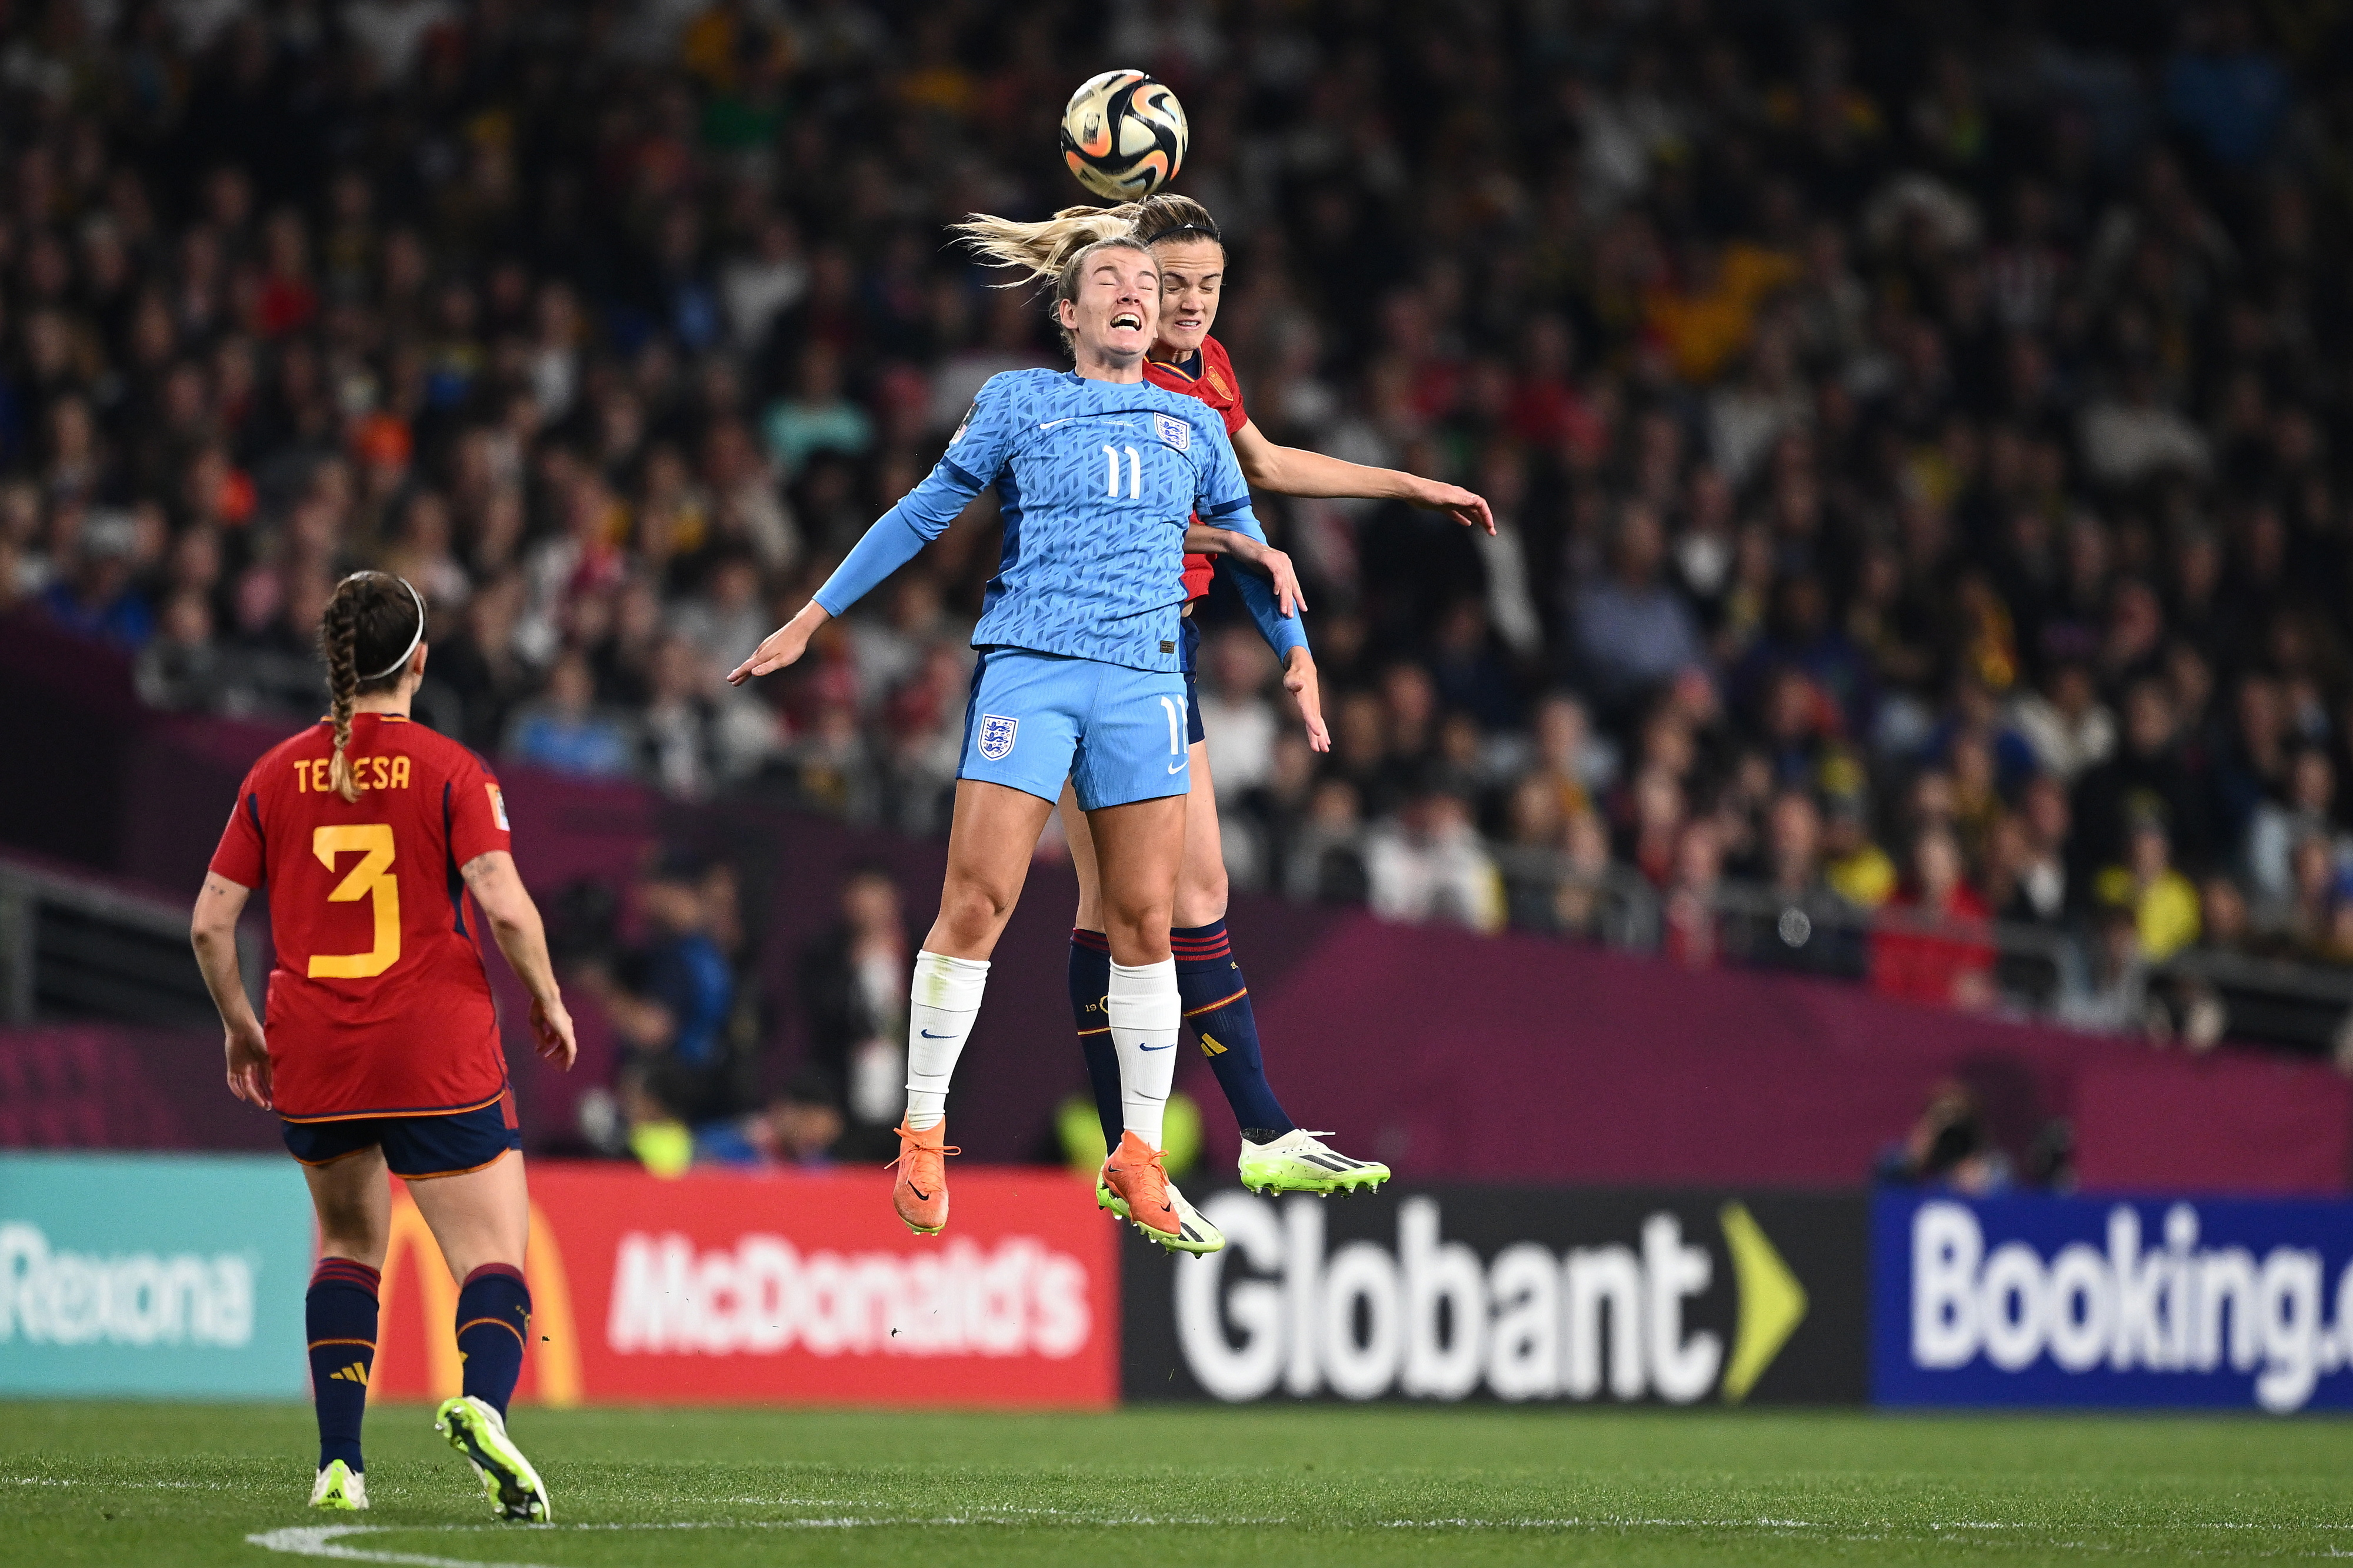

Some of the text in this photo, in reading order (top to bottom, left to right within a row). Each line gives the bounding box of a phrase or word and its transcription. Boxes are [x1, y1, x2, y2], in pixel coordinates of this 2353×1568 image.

[1102, 445, 1141, 499] 11
[294, 756, 411, 793] TEESA
[1161, 695, 1188, 755] 11
[308, 825, 401, 978] 3
[608, 1232, 1090, 1357] McDonald's
[1175, 1192, 1722, 1402] Globant
[1911, 1201, 2353, 1413] Booking.
